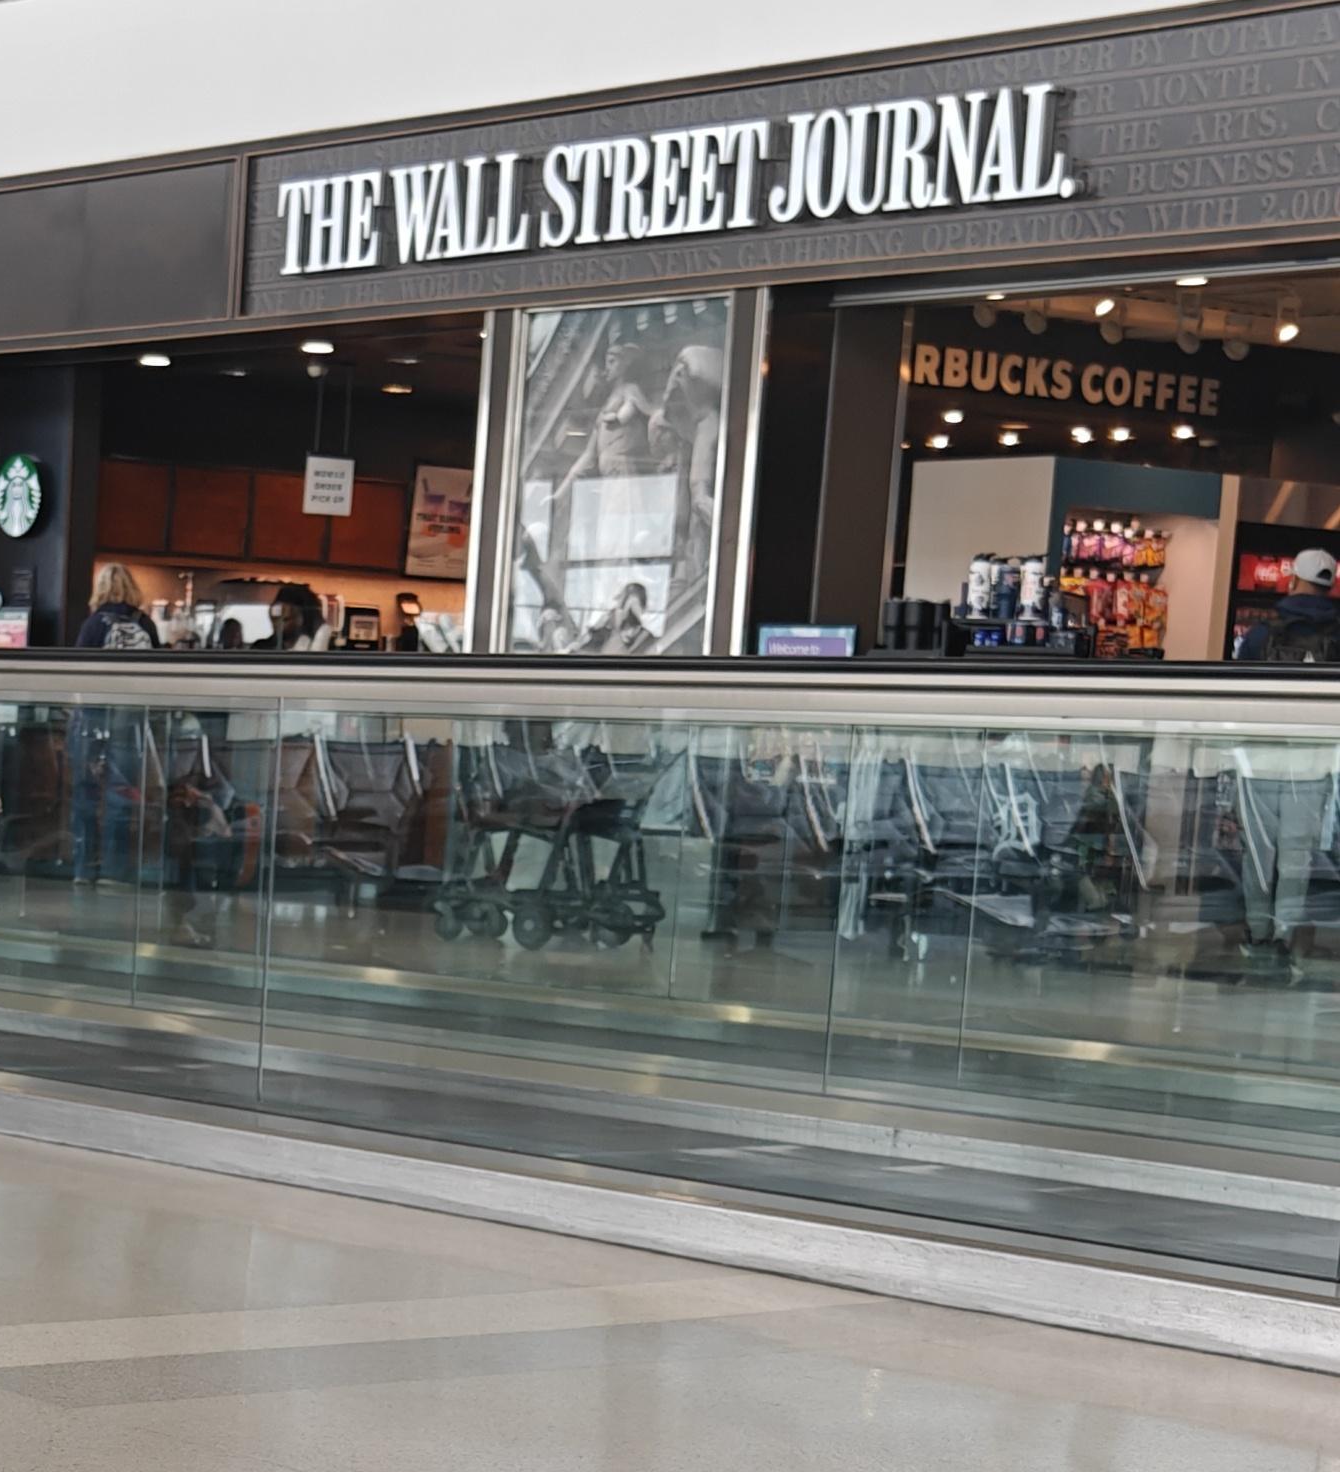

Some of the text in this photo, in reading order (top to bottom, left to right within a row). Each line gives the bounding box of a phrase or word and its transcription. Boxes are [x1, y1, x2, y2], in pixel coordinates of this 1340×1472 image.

[777, 69, 910, 116] LARGEST
[924, 40, 1116, 94] NEWSPAPER
[1126, 32, 1174, 66] BY
[1187, 16, 1301, 60] TOTAL
[1294, 55, 1336, 90] IN
[1097, 118, 1162, 155] THE
[1127, 148, 1295, 193] BUSINESS
[276, 167, 383, 276] THE
[388, 149, 530, 265] WALL
[537, 118, 771, 249] STREET
[340, 279, 384, 308] THE
[518, 256, 632, 291] LARGEST
[646, 245, 722, 278] NEWS
[737, 227, 904, 270] GATHERING
[922, 206, 1126, 254] OPERATIONS
[1146, 196, 1241, 233] WITH
[913, 343, 1222, 417] RBUCKS COFFEE
